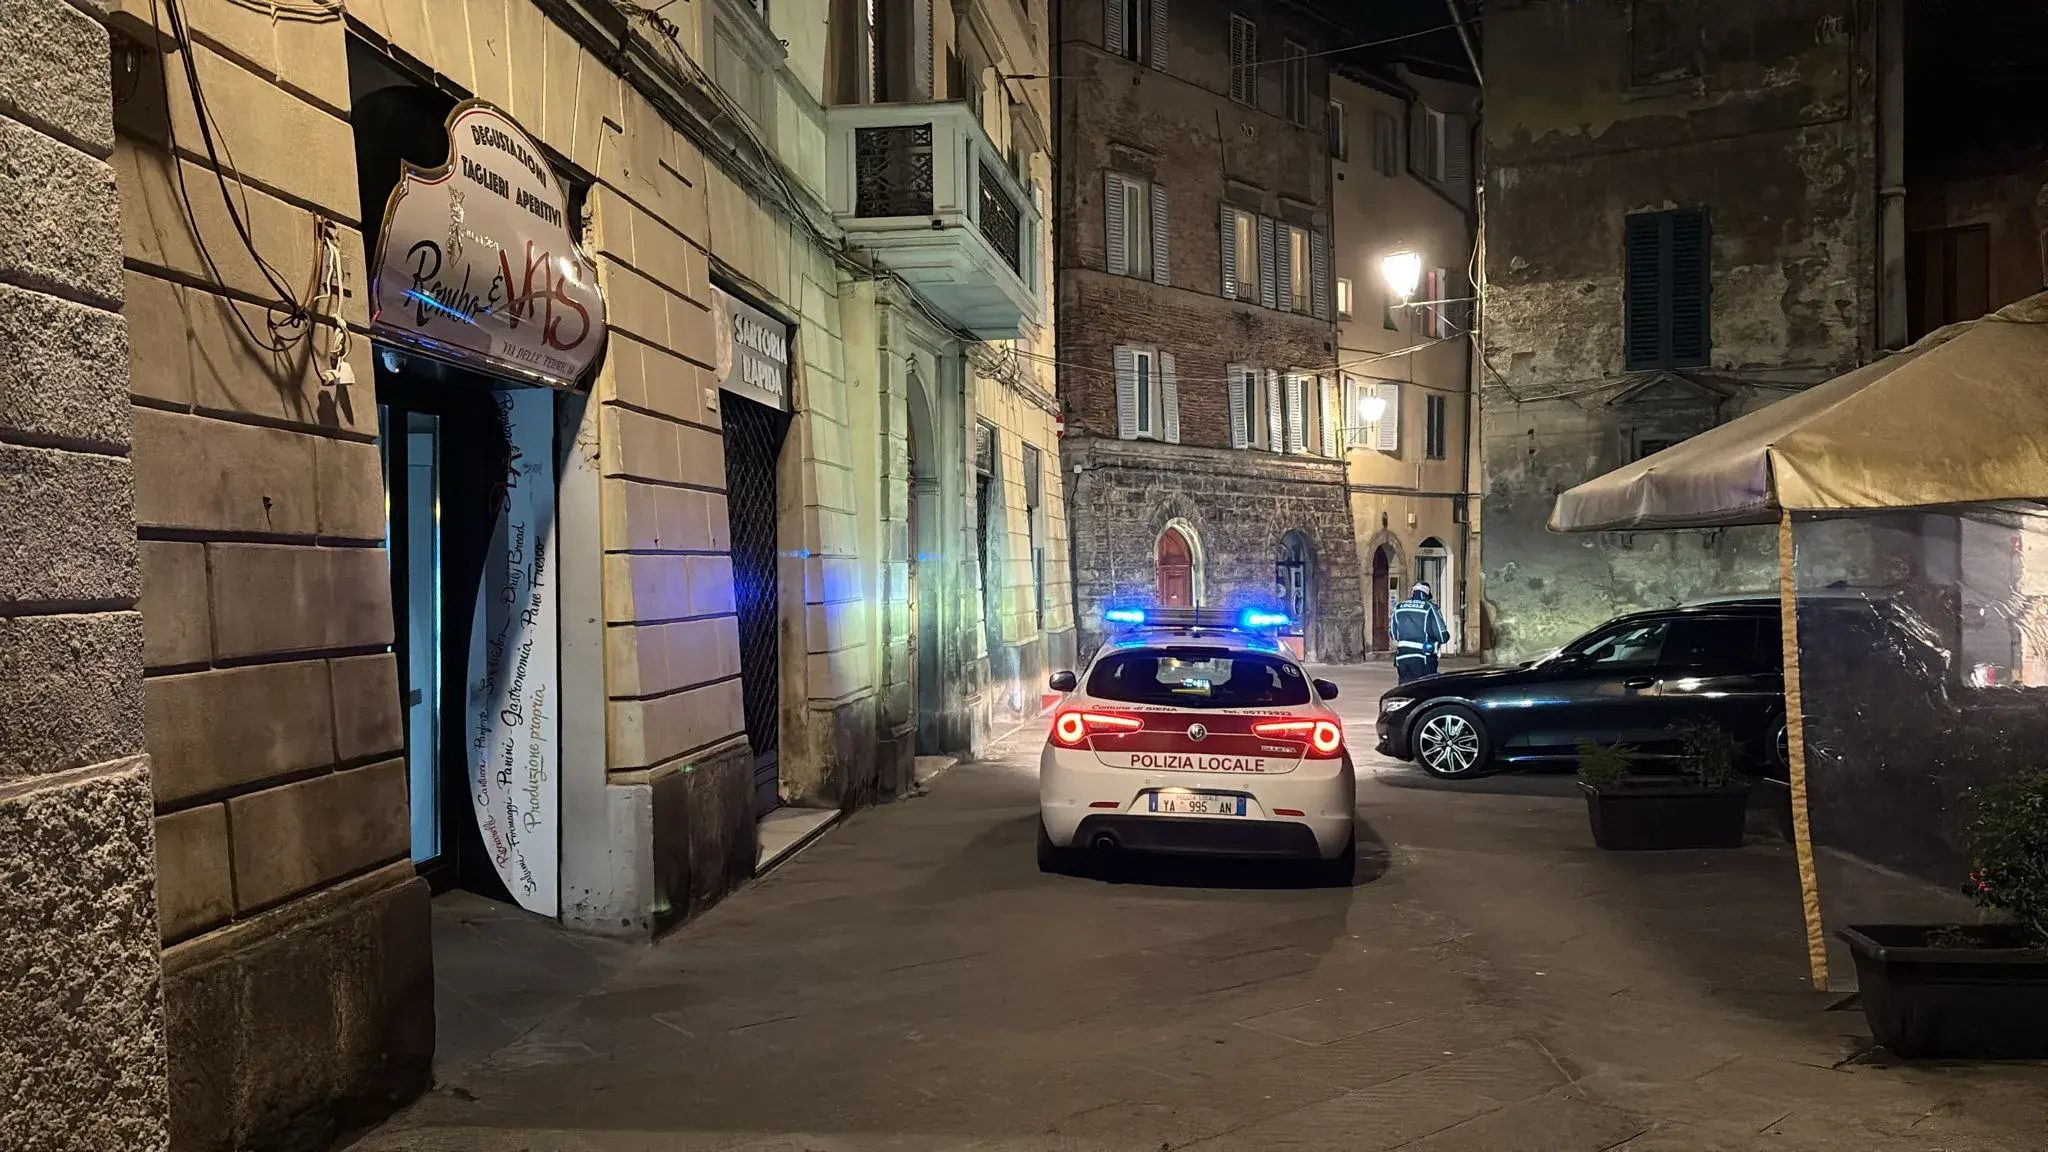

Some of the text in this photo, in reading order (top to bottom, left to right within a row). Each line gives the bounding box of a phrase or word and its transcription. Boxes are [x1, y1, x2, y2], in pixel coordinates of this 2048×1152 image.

[470, 125, 547, 188] DEGUSTAZIONI
[461, 155, 562, 228] TAGLIERI APERITIVI
[499, 240, 590, 351] VAS
[733, 313, 788, 365] SARTORIA
[742, 353, 783, 397] RAPIDA
[508, 520, 525, 565] Bread
[496, 535, 545, 896] Salumi Formaggi Panini Gastronomia Pane Fresco
[522, 684, 549, 834] Produzione propria
[1130, 754, 1265, 772] POLIZIA LOCALE
[1163, 799, 1176, 811] YA
[1189, 801, 1208, 813] 995
[1219, 802, 1232, 814] AN
